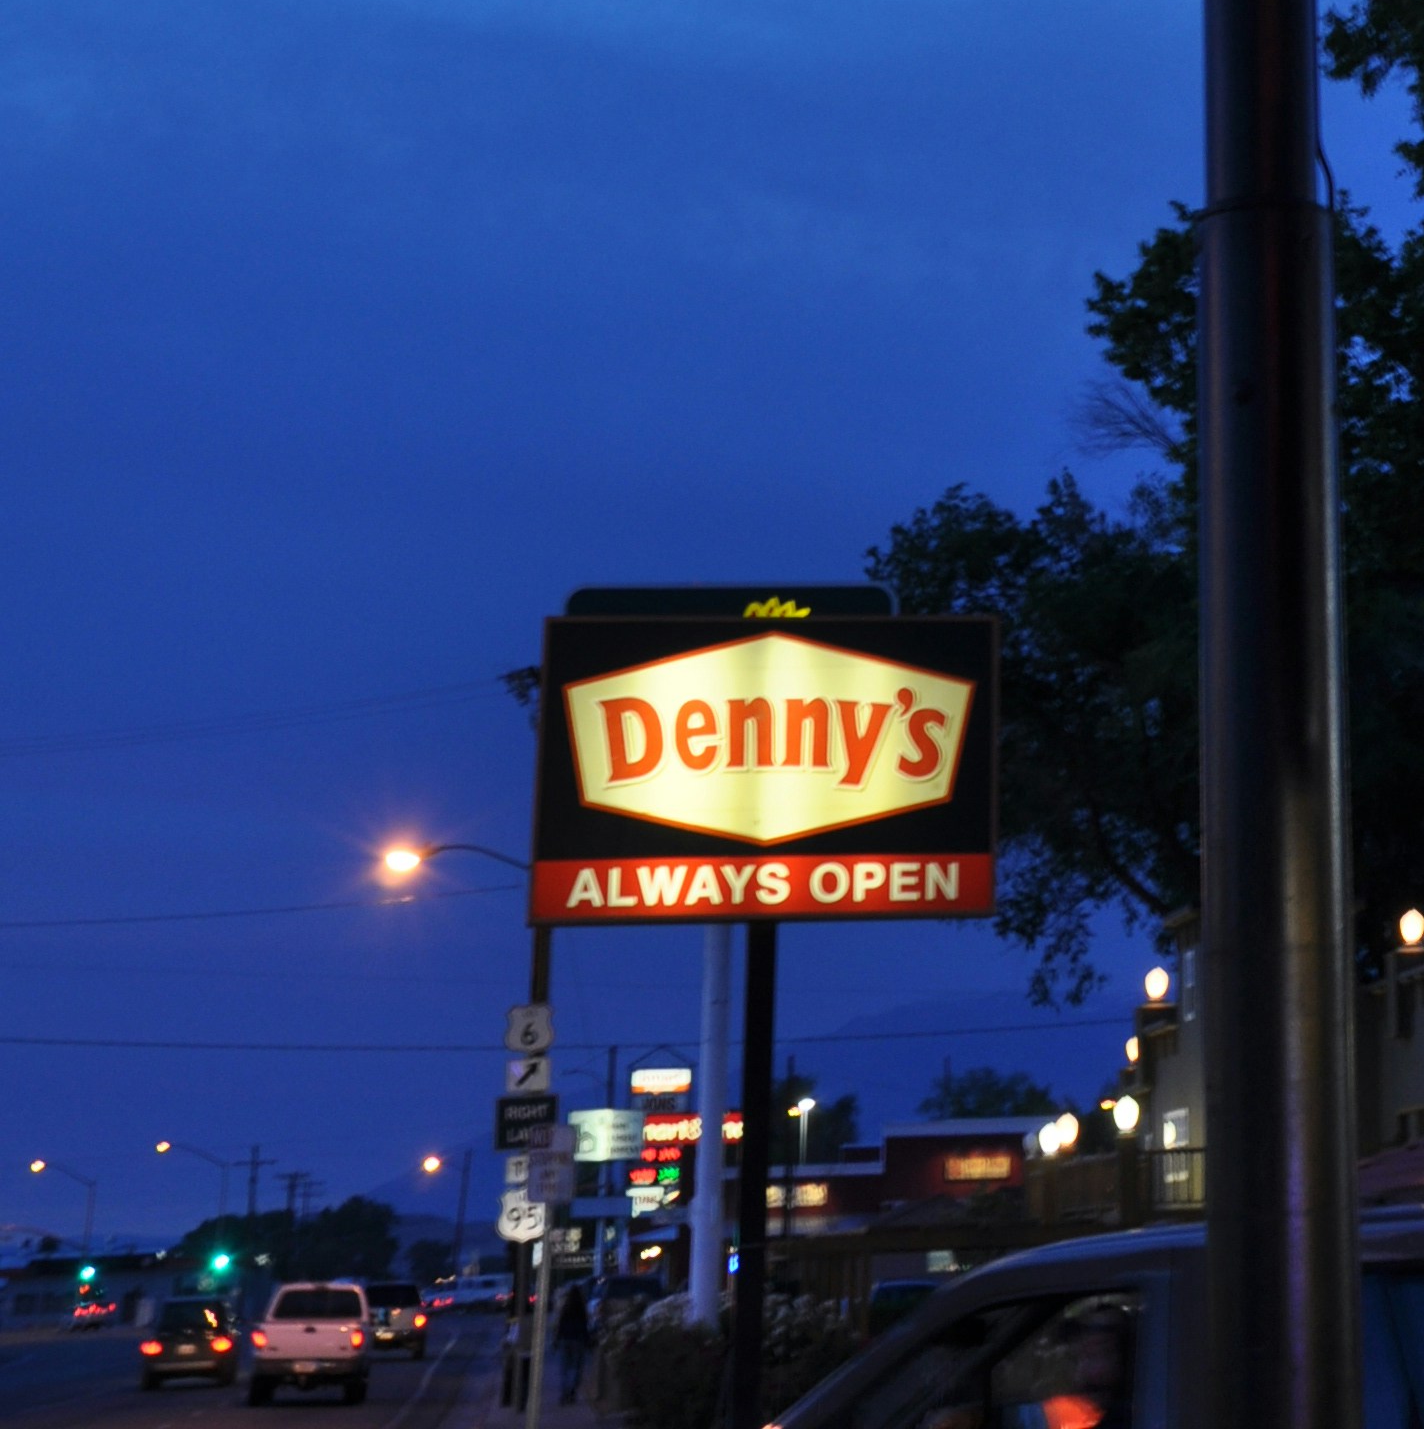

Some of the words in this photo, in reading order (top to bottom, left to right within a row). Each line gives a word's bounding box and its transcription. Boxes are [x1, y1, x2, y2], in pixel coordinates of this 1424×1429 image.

[597, 687, 948, 791] Denny's
[566, 863, 791, 908] ALWAYS
[809, 861, 960, 903] OPEN
[522, 1023, 537, 1045] 6
[504, 1103, 549, 1121] RIGHT
